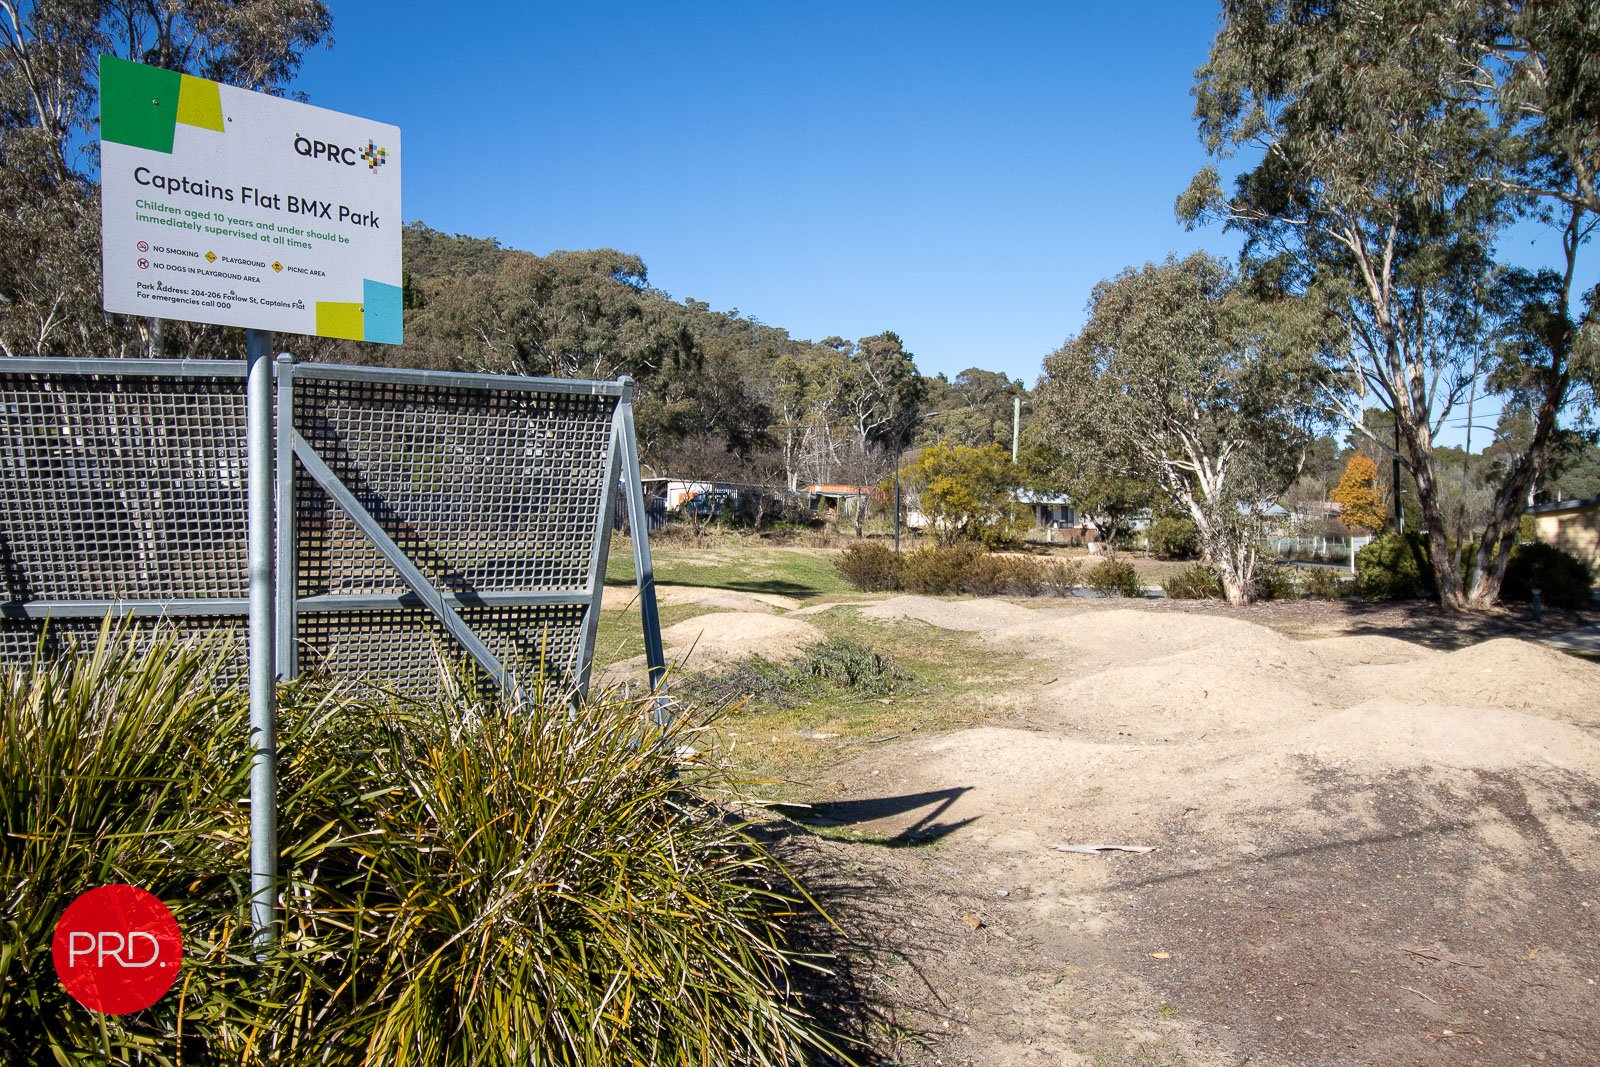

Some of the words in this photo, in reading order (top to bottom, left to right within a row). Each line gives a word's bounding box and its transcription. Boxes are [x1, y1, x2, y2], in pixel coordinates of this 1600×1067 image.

[294, 136, 356, 165] QPRC
[134, 167, 234, 201] Captains
[241, 187, 280, 210] Flat
[288, 196, 332, 220] BMX
[339, 206, 380, 228] Park
[136, 199, 181, 215] Children
[185, 209, 210, 221] aged
[214, 213, 224, 222] 10
[227, 217, 253, 228] years
[256, 220, 274, 231] and
[277, 225, 304, 236] under
[306, 229, 336, 242] should
[339, 234, 349, 244] be
[136, 212, 202, 232] immediately
[205, 226, 257, 240] supervised
[260, 233, 270, 242] at
[273, 235, 284, 245] all
[287, 238, 312, 249] times
[166, 247, 199, 258] SMOKING
[222, 256, 265, 268] PLAYGROUND
[166, 265, 186, 273] DOGS
[197, 268, 242, 281] PLAYGROUND
[288, 266, 308, 274] PICNIC
[137, 282, 154, 291] Park
[157, 284, 189, 295] Address:
[191, 289, 221, 299] 204-206
[223, 293, 247, 303] Foxlow
[260, 299, 290, 309] Captains
[137, 291, 149, 299] For
[152, 294, 199, 306] emergencies
[202, 299, 215, 307] call
